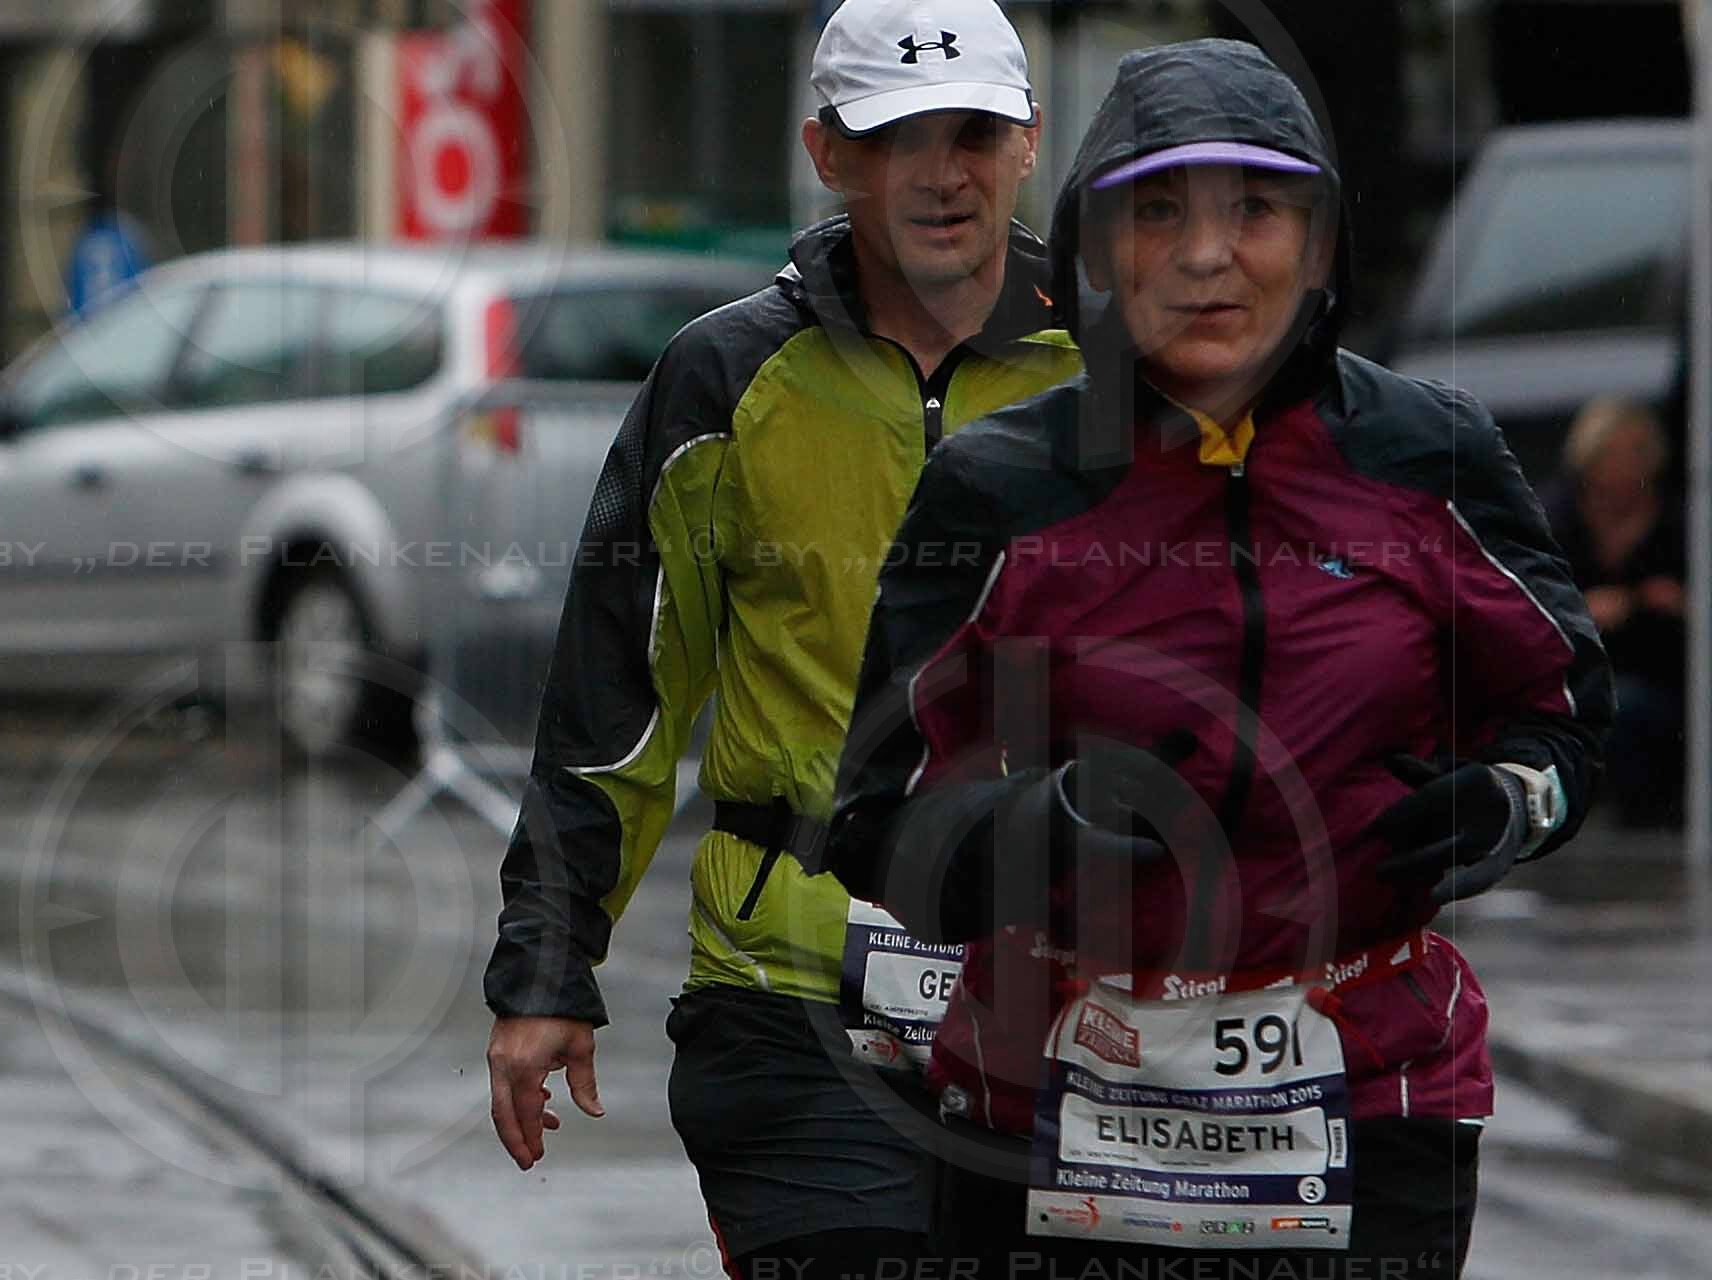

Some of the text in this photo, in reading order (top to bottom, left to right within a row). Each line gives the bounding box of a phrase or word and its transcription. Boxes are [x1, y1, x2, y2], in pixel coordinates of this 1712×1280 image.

[868, 931, 911, 949] KLEINE
[1212, 1090, 1288, 1110] MARATHON
[1289, 1083, 1323, 1105] 2015
[1097, 1114, 1295, 1153] ELISABETH
[1055, 1168, 1251, 1199] Kleine Zeitung Marathon
